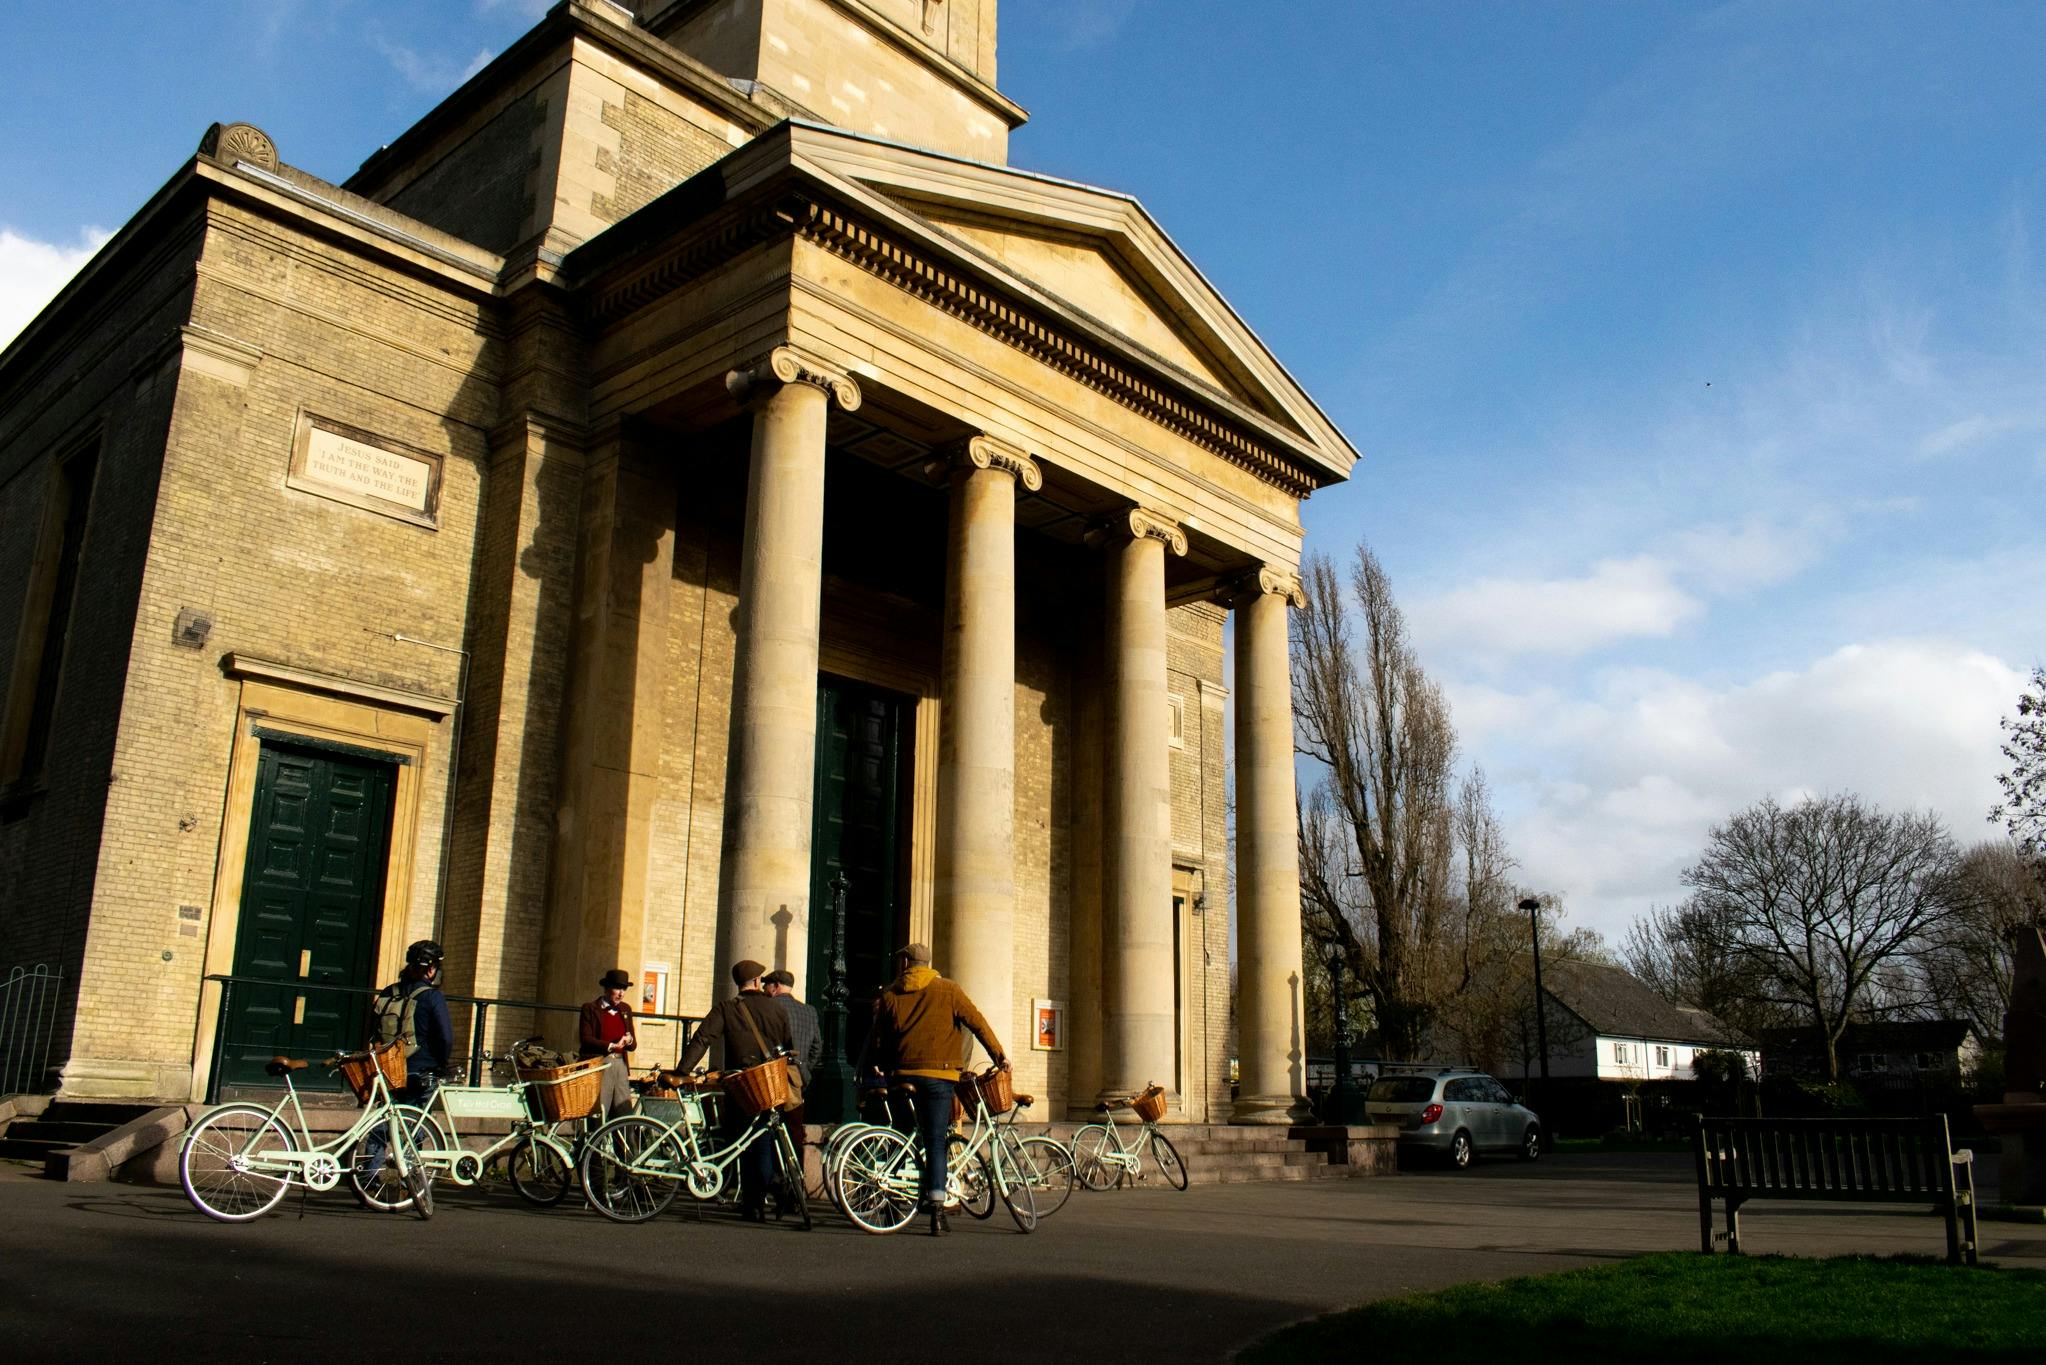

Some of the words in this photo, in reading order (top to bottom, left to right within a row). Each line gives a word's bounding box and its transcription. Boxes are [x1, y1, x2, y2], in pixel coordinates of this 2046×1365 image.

[337, 443, 372, 461] JESUS
[313, 460, 347, 477] TRUTH
[350, 472, 370, 485] AND
[374, 479, 394, 492] THE
[328, 454, 345, 464] AM
[349, 459, 369, 472] THE
[398, 474, 418, 487] THE
